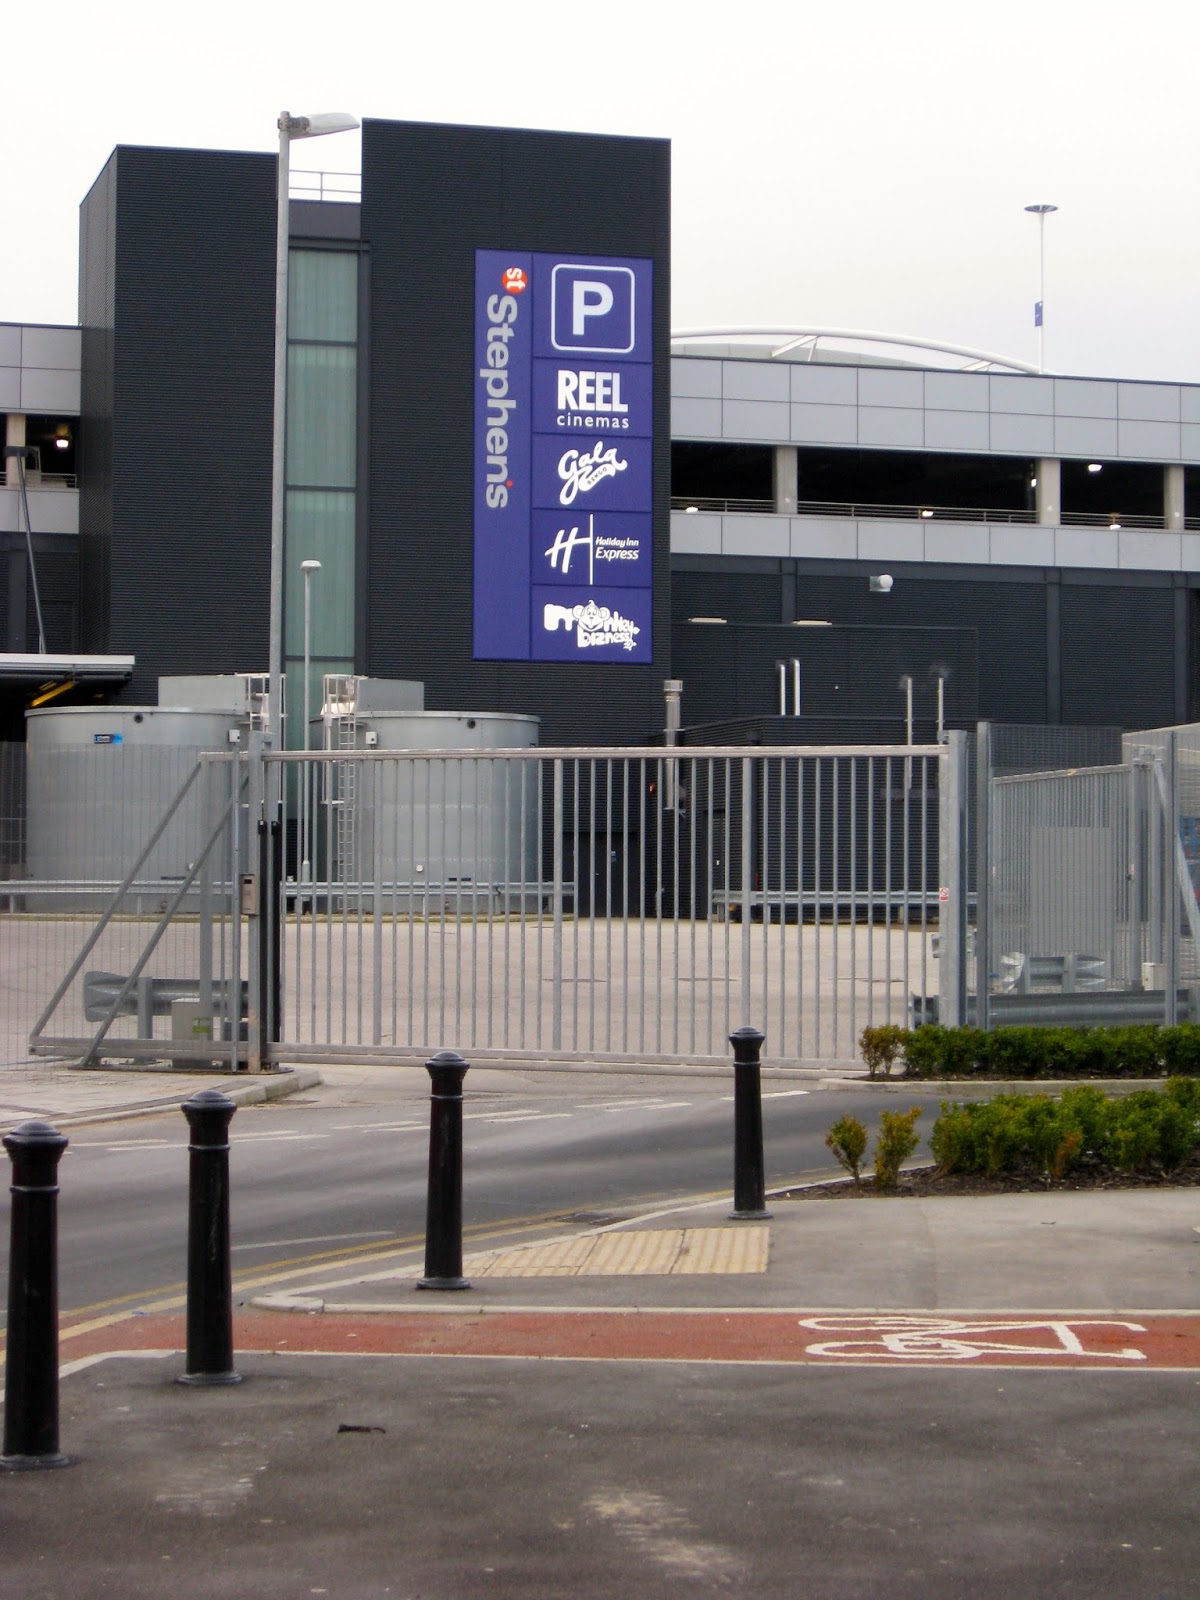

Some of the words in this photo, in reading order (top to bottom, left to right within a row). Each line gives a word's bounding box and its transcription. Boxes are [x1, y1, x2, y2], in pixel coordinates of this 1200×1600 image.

[506, 267, 526, 289] st
[572, 280, 614, 335] P
[557, 370, 629, 412] REEL
[556, 412, 629, 429] cinemas
[558, 440, 628, 505] Gala
[595, 536, 625, 548] Holiday
[626, 537, 640, 547] Inn
[595, 546, 640, 562] Express
